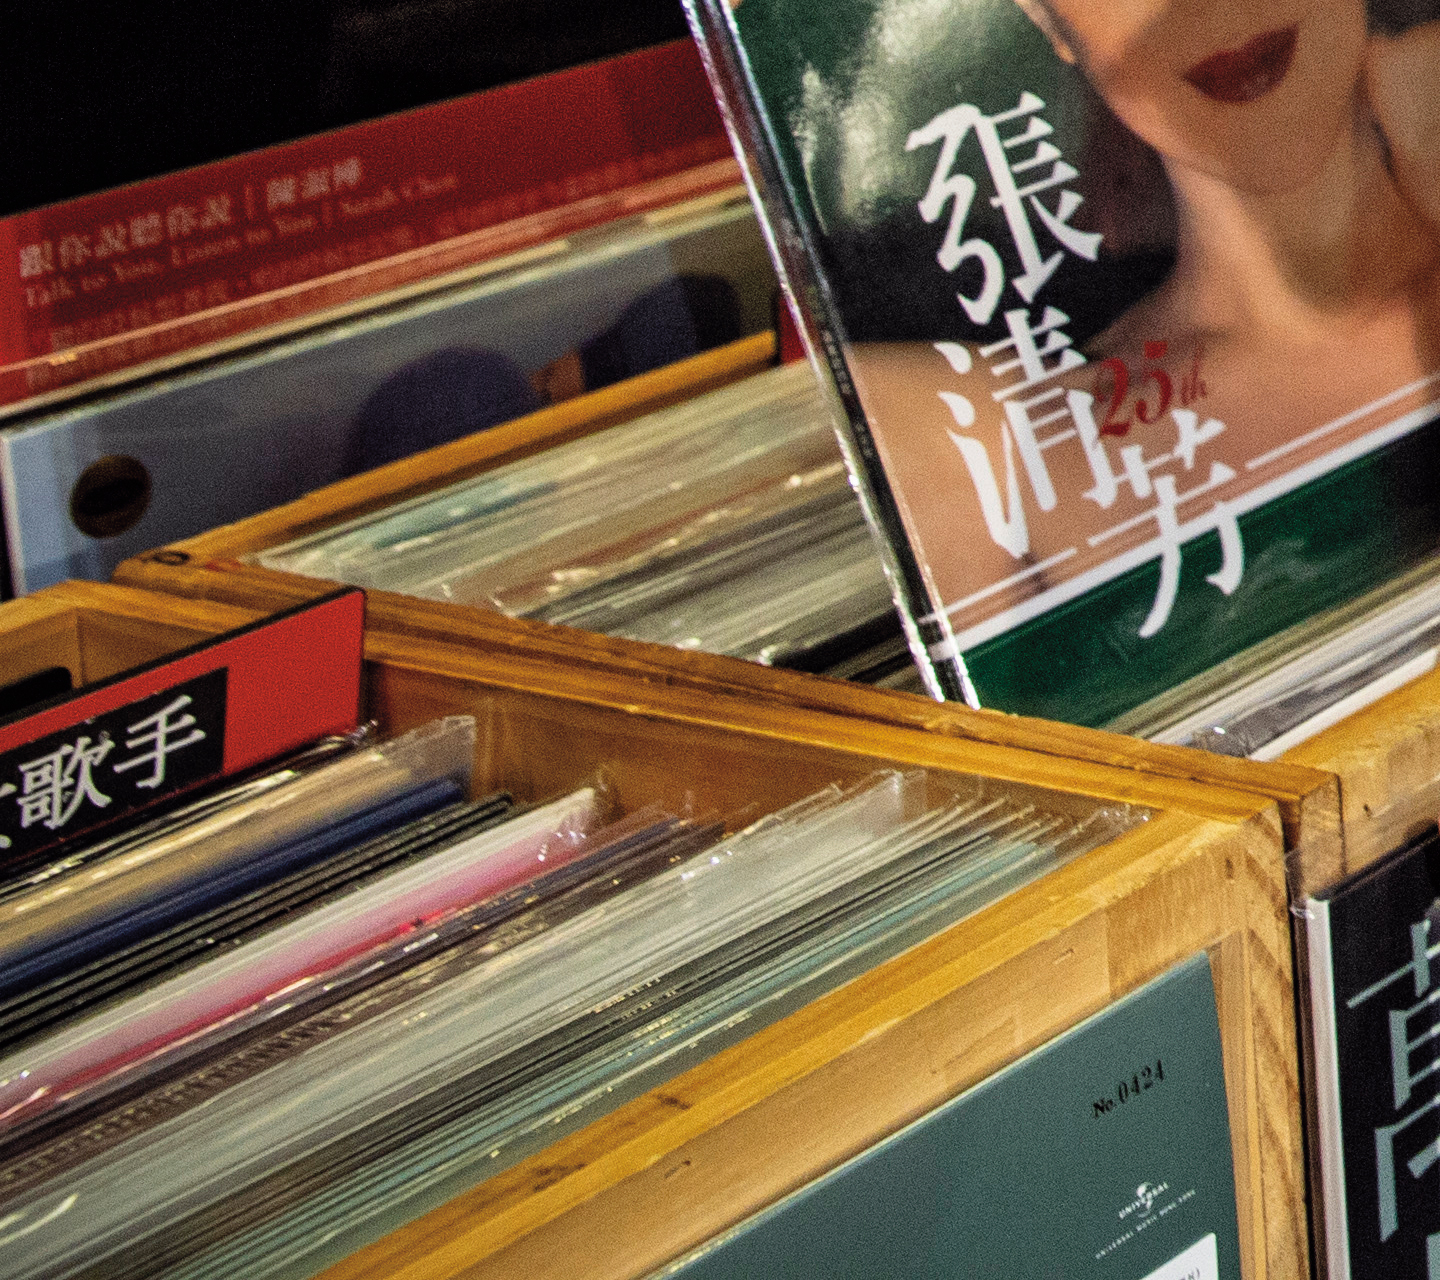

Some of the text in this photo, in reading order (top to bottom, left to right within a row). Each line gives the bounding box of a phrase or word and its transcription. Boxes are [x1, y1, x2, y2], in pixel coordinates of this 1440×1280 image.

[906, 91, 1245, 637] 張清芳
[0, 694, 207, 849] 歌手
[1118, 1181, 1170, 1220] UNIVERSAL
